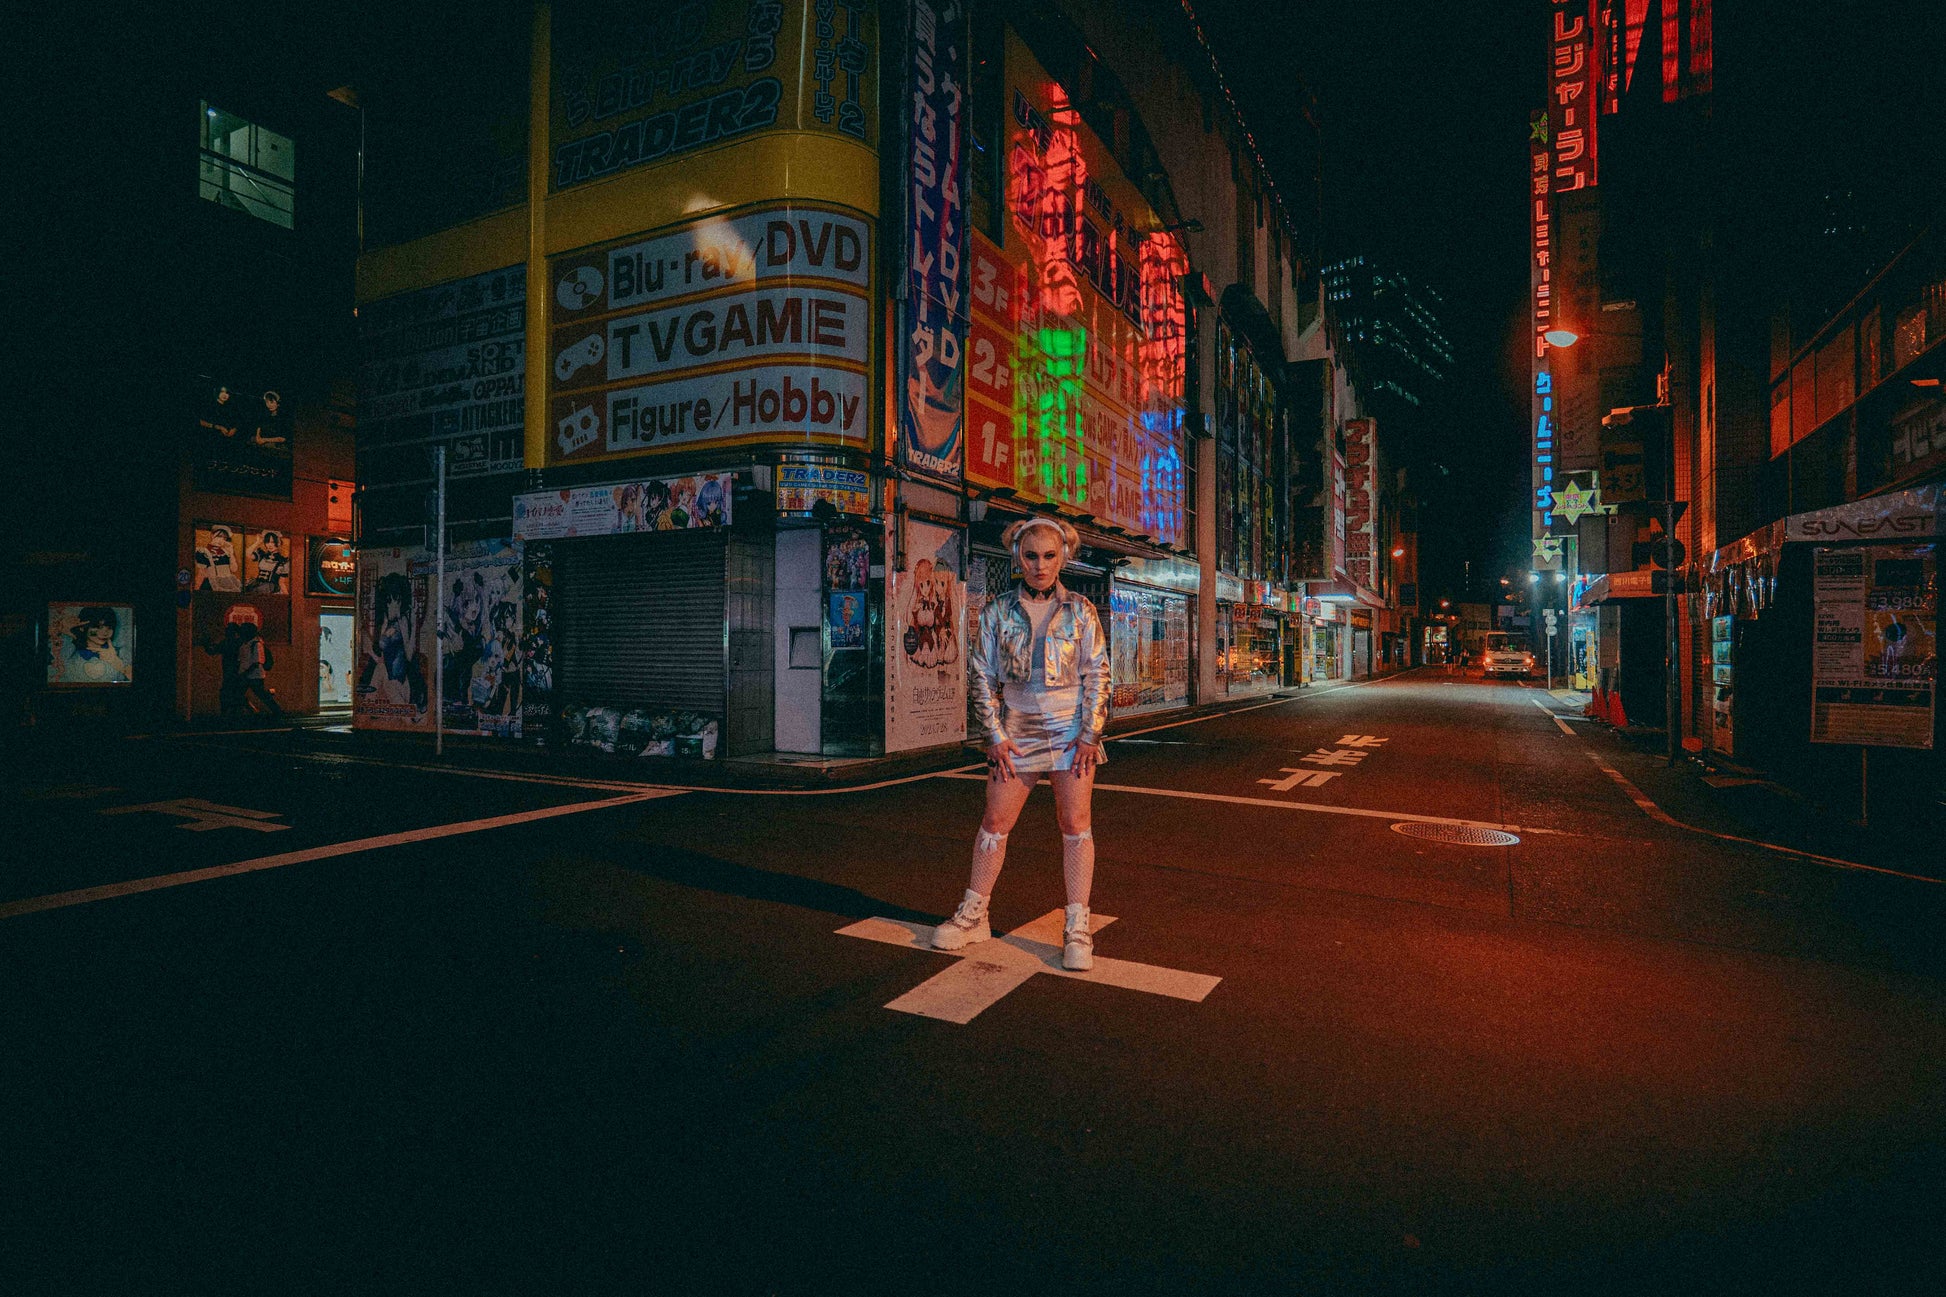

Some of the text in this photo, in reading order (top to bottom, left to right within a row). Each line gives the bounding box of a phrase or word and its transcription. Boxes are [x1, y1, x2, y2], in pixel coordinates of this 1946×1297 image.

[837, 0, 869, 139] ーダー2
[555, 77, 782, 187] TRADER2
[973, 255, 1010, 312] 3F
[972, 338, 1010, 391] 2F
[908, 446, 960, 476] TRADER2
[981, 421, 1009, 468] 1F
[782, 467, 867, 485] TRADER2
